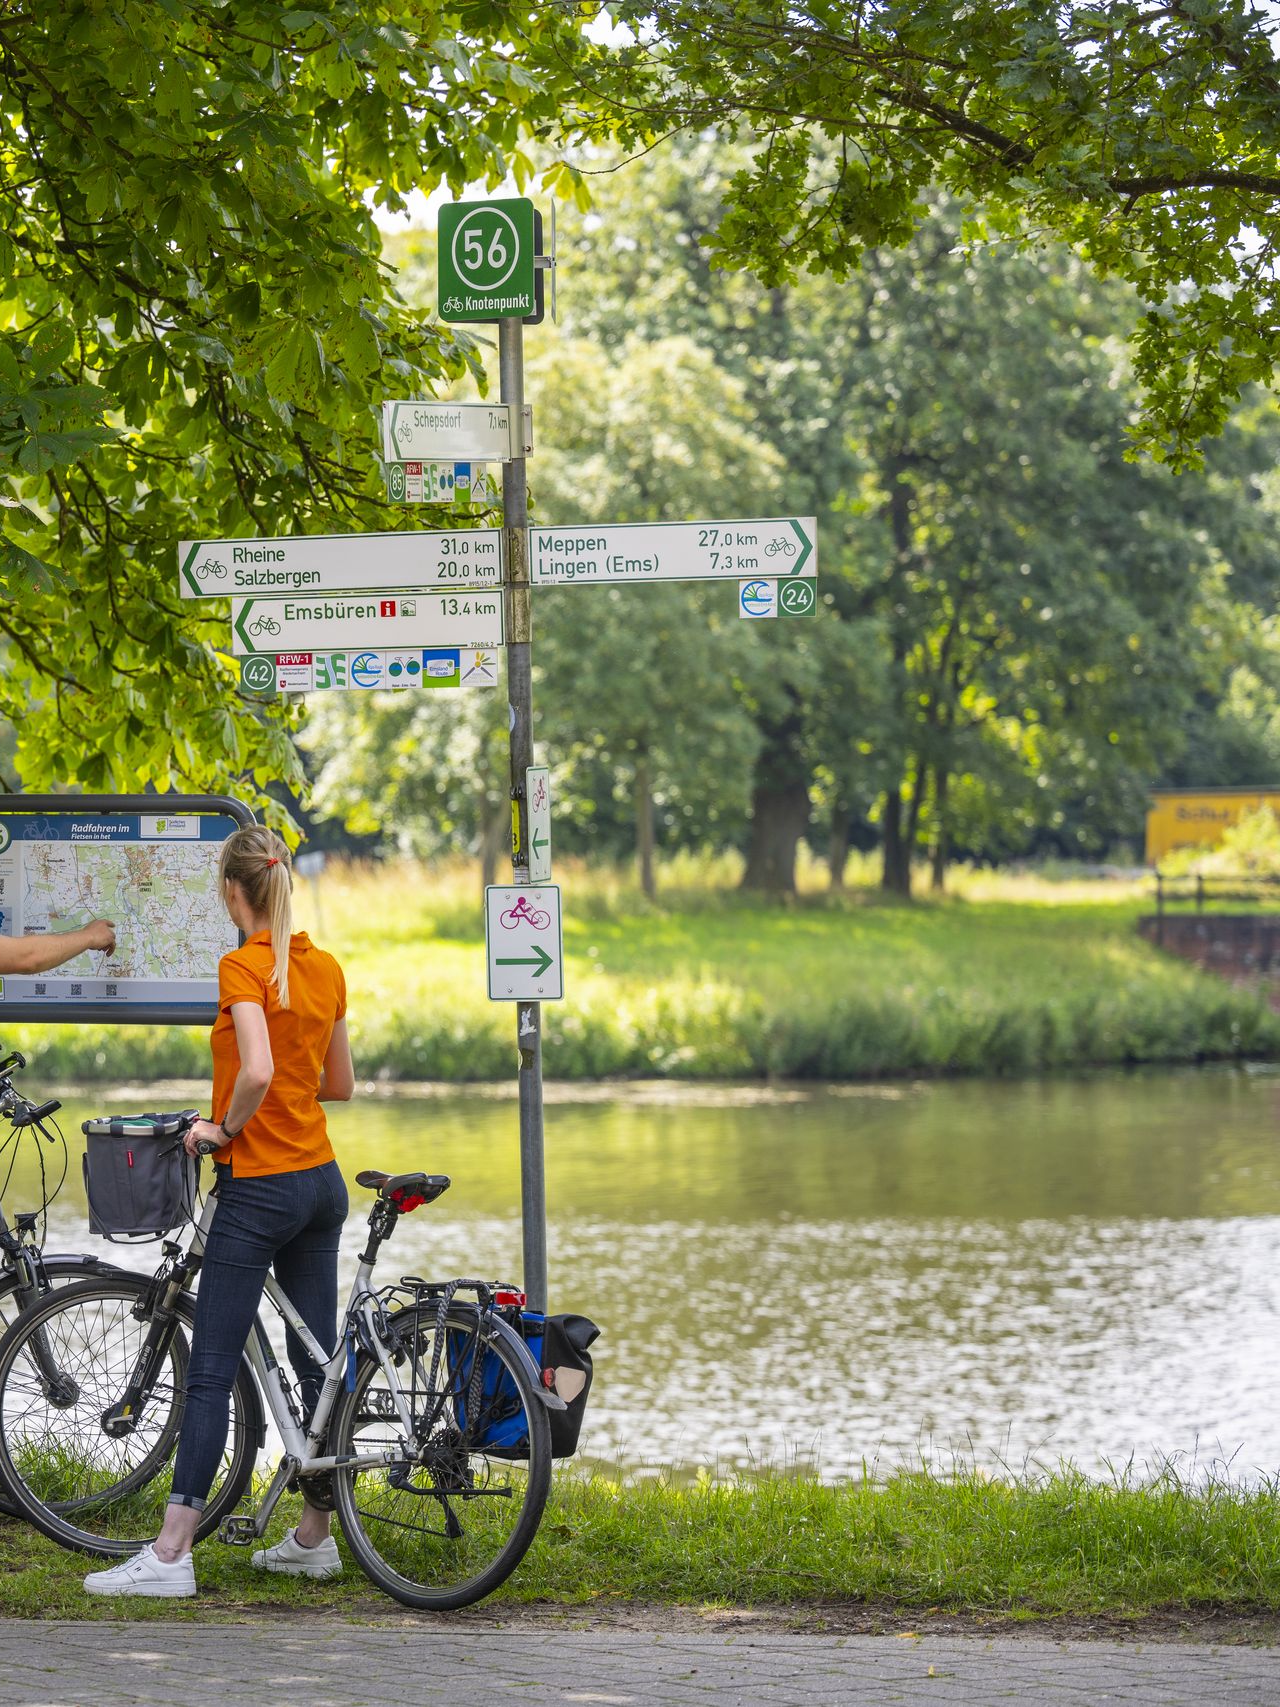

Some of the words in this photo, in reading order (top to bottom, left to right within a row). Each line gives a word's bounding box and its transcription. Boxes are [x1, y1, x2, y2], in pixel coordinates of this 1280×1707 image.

[464, 227, 507, 270] 56
[465, 293, 530, 312] Knotenpunkt
[413, 410, 461, 432] Schepsdorf
[498, 416, 508, 429] km
[406, 464, 421, 474] RFW-1
[232, 546, 286, 563] Rheine
[441, 538, 469, 555] 31,0
[474, 541, 495, 553] km
[538, 535, 607, 556] Meppen
[698, 529, 733, 547] 27,0
[736, 533, 758, 546] km
[234, 569, 321, 588] Salzbergen
[437, 561, 470, 578] 20,0
[475, 564, 495, 577] km
[539, 558, 597, 578] Lingen
[606, 553, 659, 574] (Ems)
[710, 552, 733, 570] 7,3
[737, 556, 759, 568] km
[786, 588, 808, 606] 24
[284, 602, 377, 620] Emsbüren
[440, 598, 471, 616] 13,4
[475, 602, 496, 615] km
[279, 654, 309, 664] RFW-1
[248, 665, 269, 682] 42
[71, 823, 118, 833] Radfahren
[118, 823, 130, 833] im
